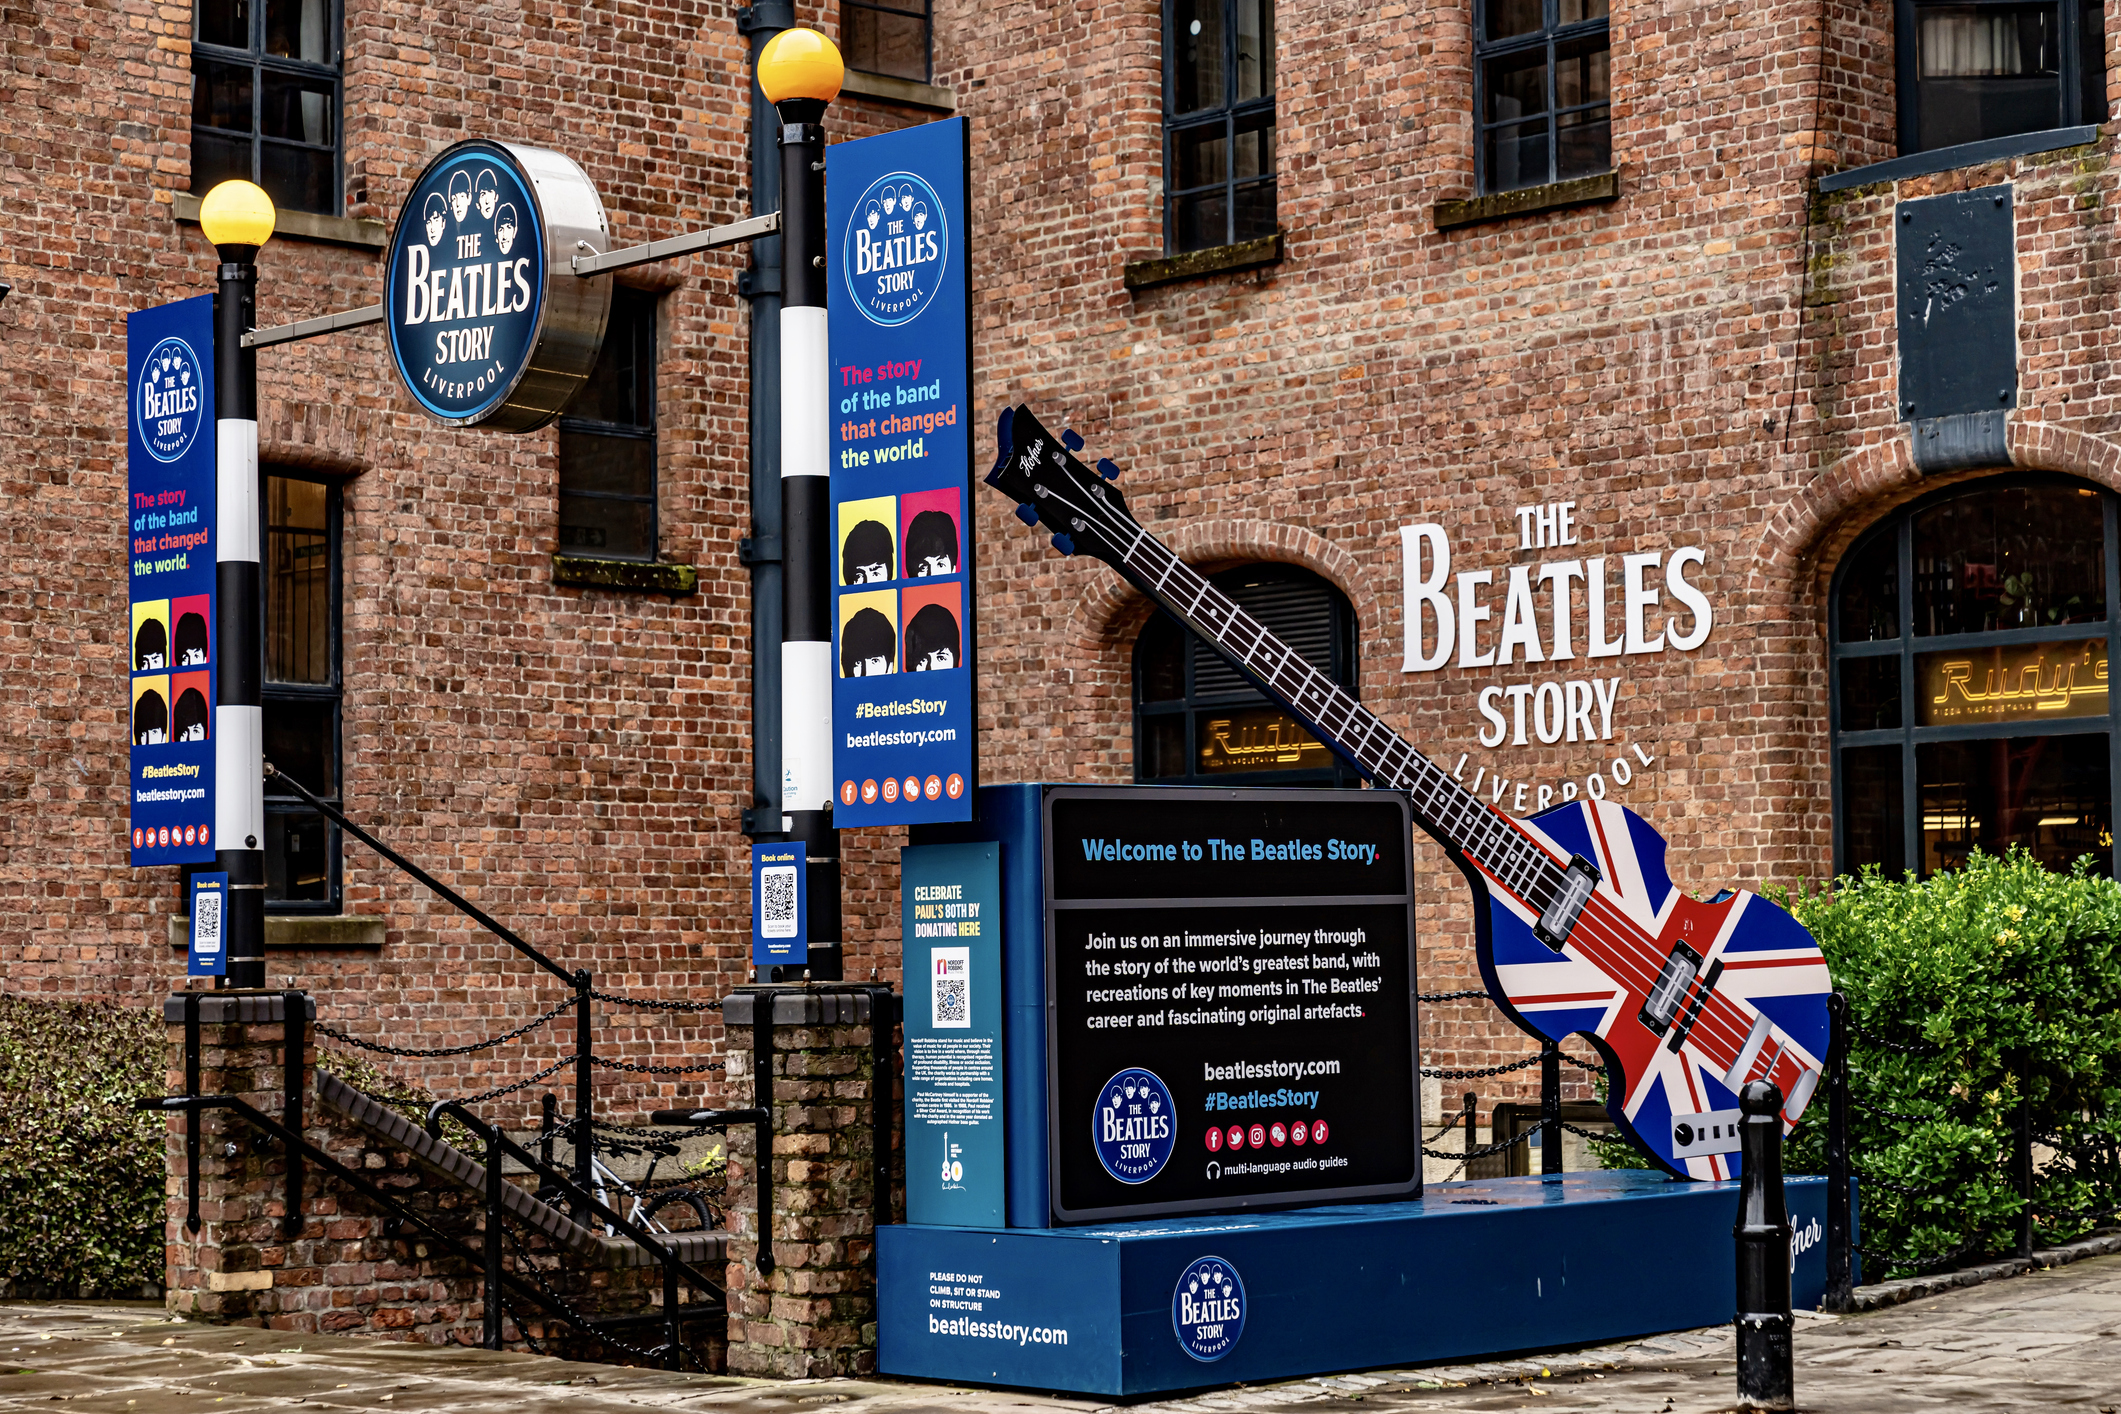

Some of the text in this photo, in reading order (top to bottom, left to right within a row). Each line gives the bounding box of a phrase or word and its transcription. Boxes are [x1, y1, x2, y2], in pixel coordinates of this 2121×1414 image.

[887, 220, 904, 235] THE
[456, 233, 481, 259] THE
[856, 229, 938, 275] BEATLES
[404, 244, 530, 325] BEATLES
[878, 270, 915, 295] STORY
[871, 288, 923, 312] LIVERPOOL
[436, 326, 494, 364] STORY
[164, 376, 175, 388] THE
[423, 359, 504, 399] LIVERPOOL
[840, 359, 922, 386] The story
[145, 382, 197, 419] BEATLES
[841, 379, 939, 413] of the band
[158, 417, 182, 436] STORY
[841, 404, 956, 441] that changed
[154, 432, 187, 451] LIVERPOOL
[841, 438, 928, 468] the world.
[134, 490, 186, 509] The story
[134, 506, 197, 531] of the band
[1515, 501, 1577, 550] THE
[134, 527, 207, 554] that changed
[134, 553, 190, 576] the world.
[1400, 523, 1713, 673] BEATLES
[856, 699, 947, 718] #BeatlesStory
[1478, 677, 1620, 747] STORY
[847, 728, 956, 748] beatlesstory.com
[142, 763, 200, 778] #BeatlesStory
[1453, 743, 1654, 811] LIVERPOOL
[137, 788, 204, 802] beatlesstory.com
[1082, 839, 1380, 865] Welcome to The Beatles Story.
[915, 885, 962, 901] CELEBRATE
[915, 903, 980, 919] PAUL'S 80TH BY
[915, 922, 980, 937] DONATING HERE
[1085, 928, 1366, 950] Join us on an immersive journey through
[1086, 952, 1380, 978] the story of the world's greatest band, with
[1086, 976, 1381, 1003] recreations of key moments in The Beatles'
[1087, 1003, 1365, 1029] career and fascinating original artefacts.
[1204, 1060, 1340, 1081] beatlesstory.com
[1129, 1104, 1142, 1115] THE
[1205, 1088, 1319, 1111] #BeatlesStory
[1103, 1107, 1169, 1142] BEATLES
[1120, 1143, 1150, 1160] STORY
[1115, 1157, 1157, 1174] LIVERPOOL
[1224, 1157, 1348, 1176] multi-language audio guides
[1790, 1214, 1822, 1274] fner
[930, 1272, 982, 1284] PLEASE DO NOT
[930, 1286, 1000, 1299] CLIMB, SIT OR STAND
[1204, 1289, 1216, 1299] THE
[930, 1299, 982, 1311] ON STRUCTURE
[1181, 1292, 1240, 1325] BEATLES
[929, 1314, 1068, 1346] beatlesstory.com
[1197, 1325, 1224, 1340] STORY
[1192, 1337, 1230, 1353] LIVERPOOL
